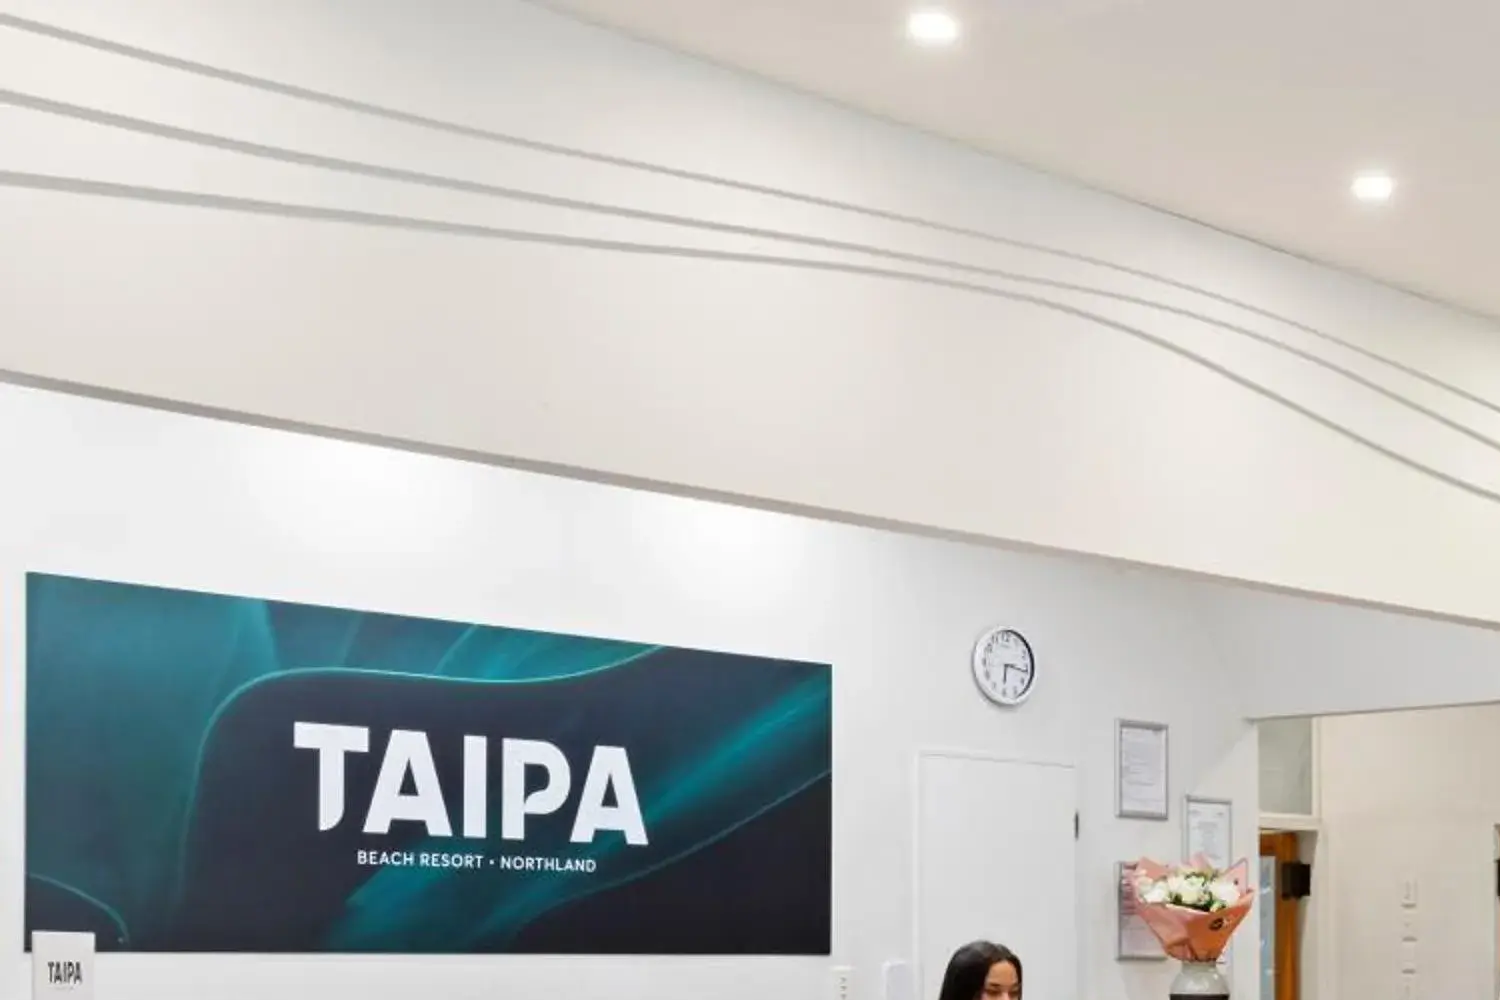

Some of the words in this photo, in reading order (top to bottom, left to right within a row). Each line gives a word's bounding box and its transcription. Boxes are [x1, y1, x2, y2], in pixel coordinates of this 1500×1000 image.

[293, 721, 650, 846] TAIPA
[356, 849, 415, 867] BEACH
[418, 852, 484, 869] RESORT
[499, 855, 597, 873] NORTHLAND
[48, 961, 83, 984] TAIPA
